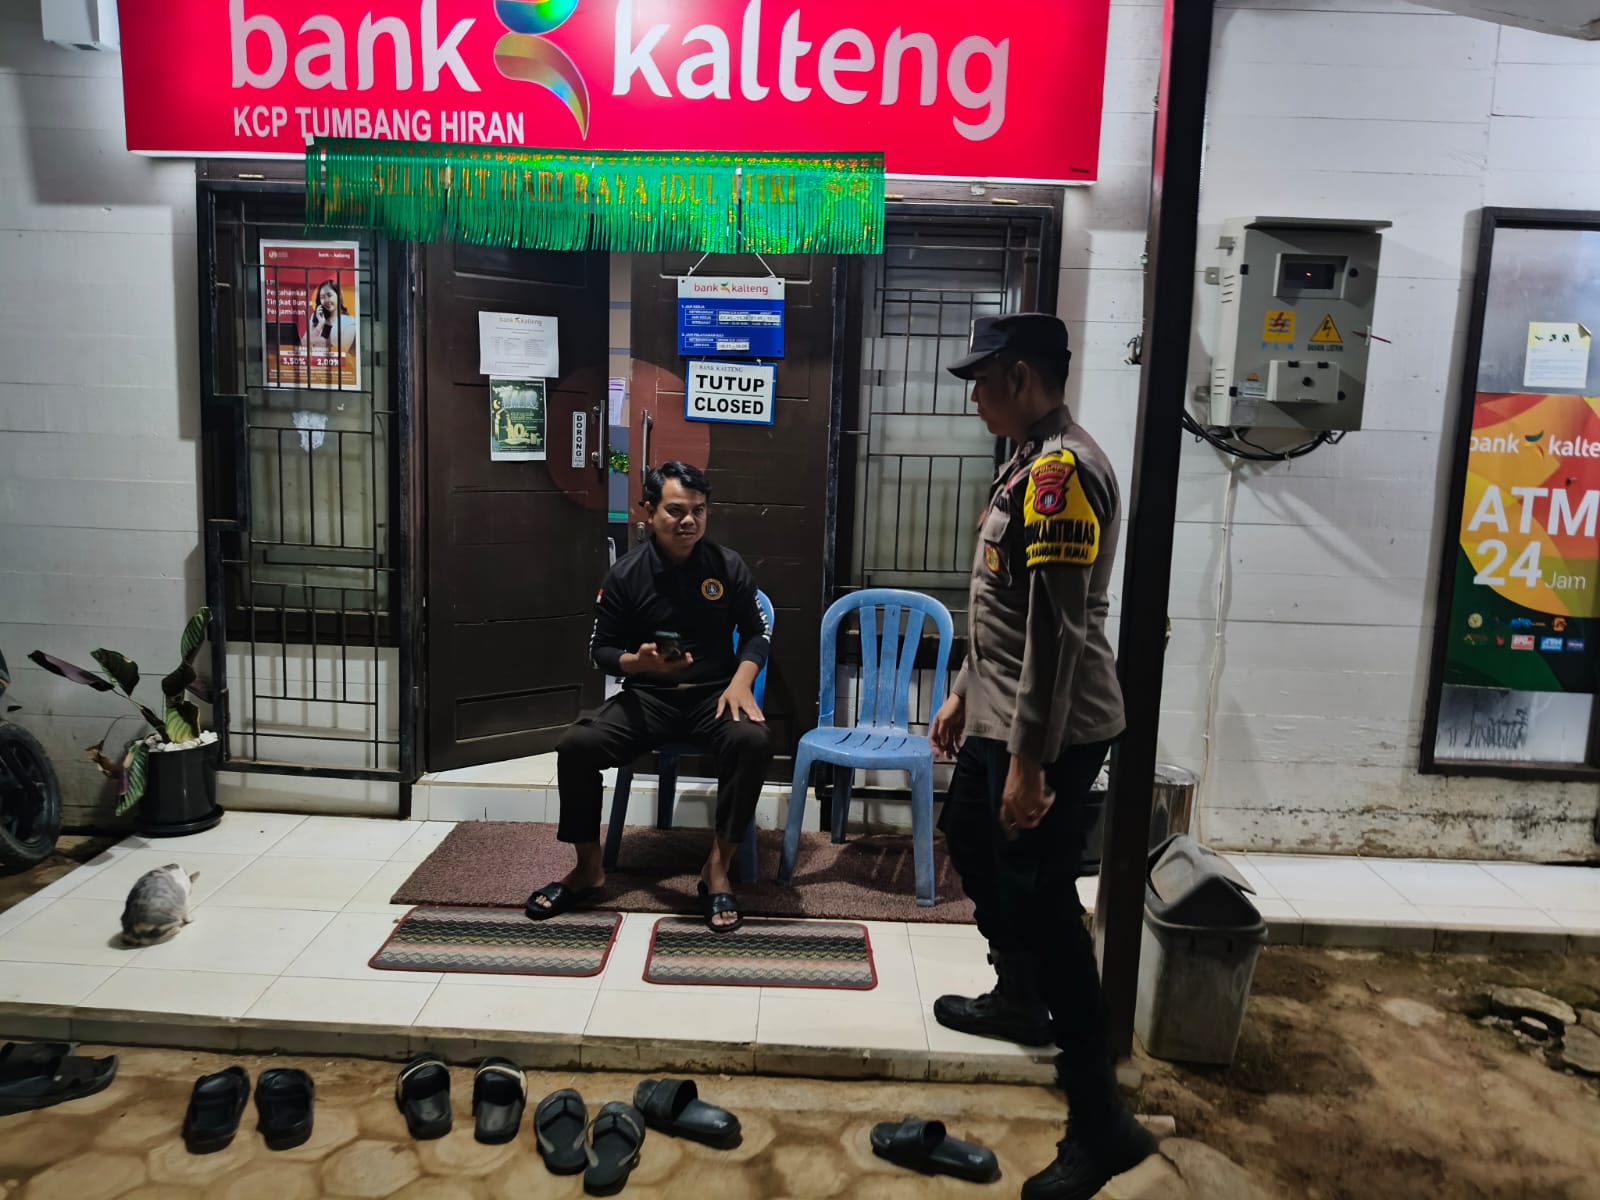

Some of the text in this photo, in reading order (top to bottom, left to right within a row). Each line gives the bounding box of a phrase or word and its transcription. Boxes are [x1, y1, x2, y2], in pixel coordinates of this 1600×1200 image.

[229, 0, 1010, 141] bank kalteng
[233, 105, 525, 145] KCP TUMBANG HIRAN
[501, 169, 563, 203] HARI
[573, 172, 648, 204] RAYA
[694, 283, 769, 295] bank kalteng
[696, 374, 765, 392] TUTUP
[694, 396, 764, 415] CLOSED
[1467, 485, 1600, 537] ATM
[1473, 538, 1586, 590] 24 Jam
